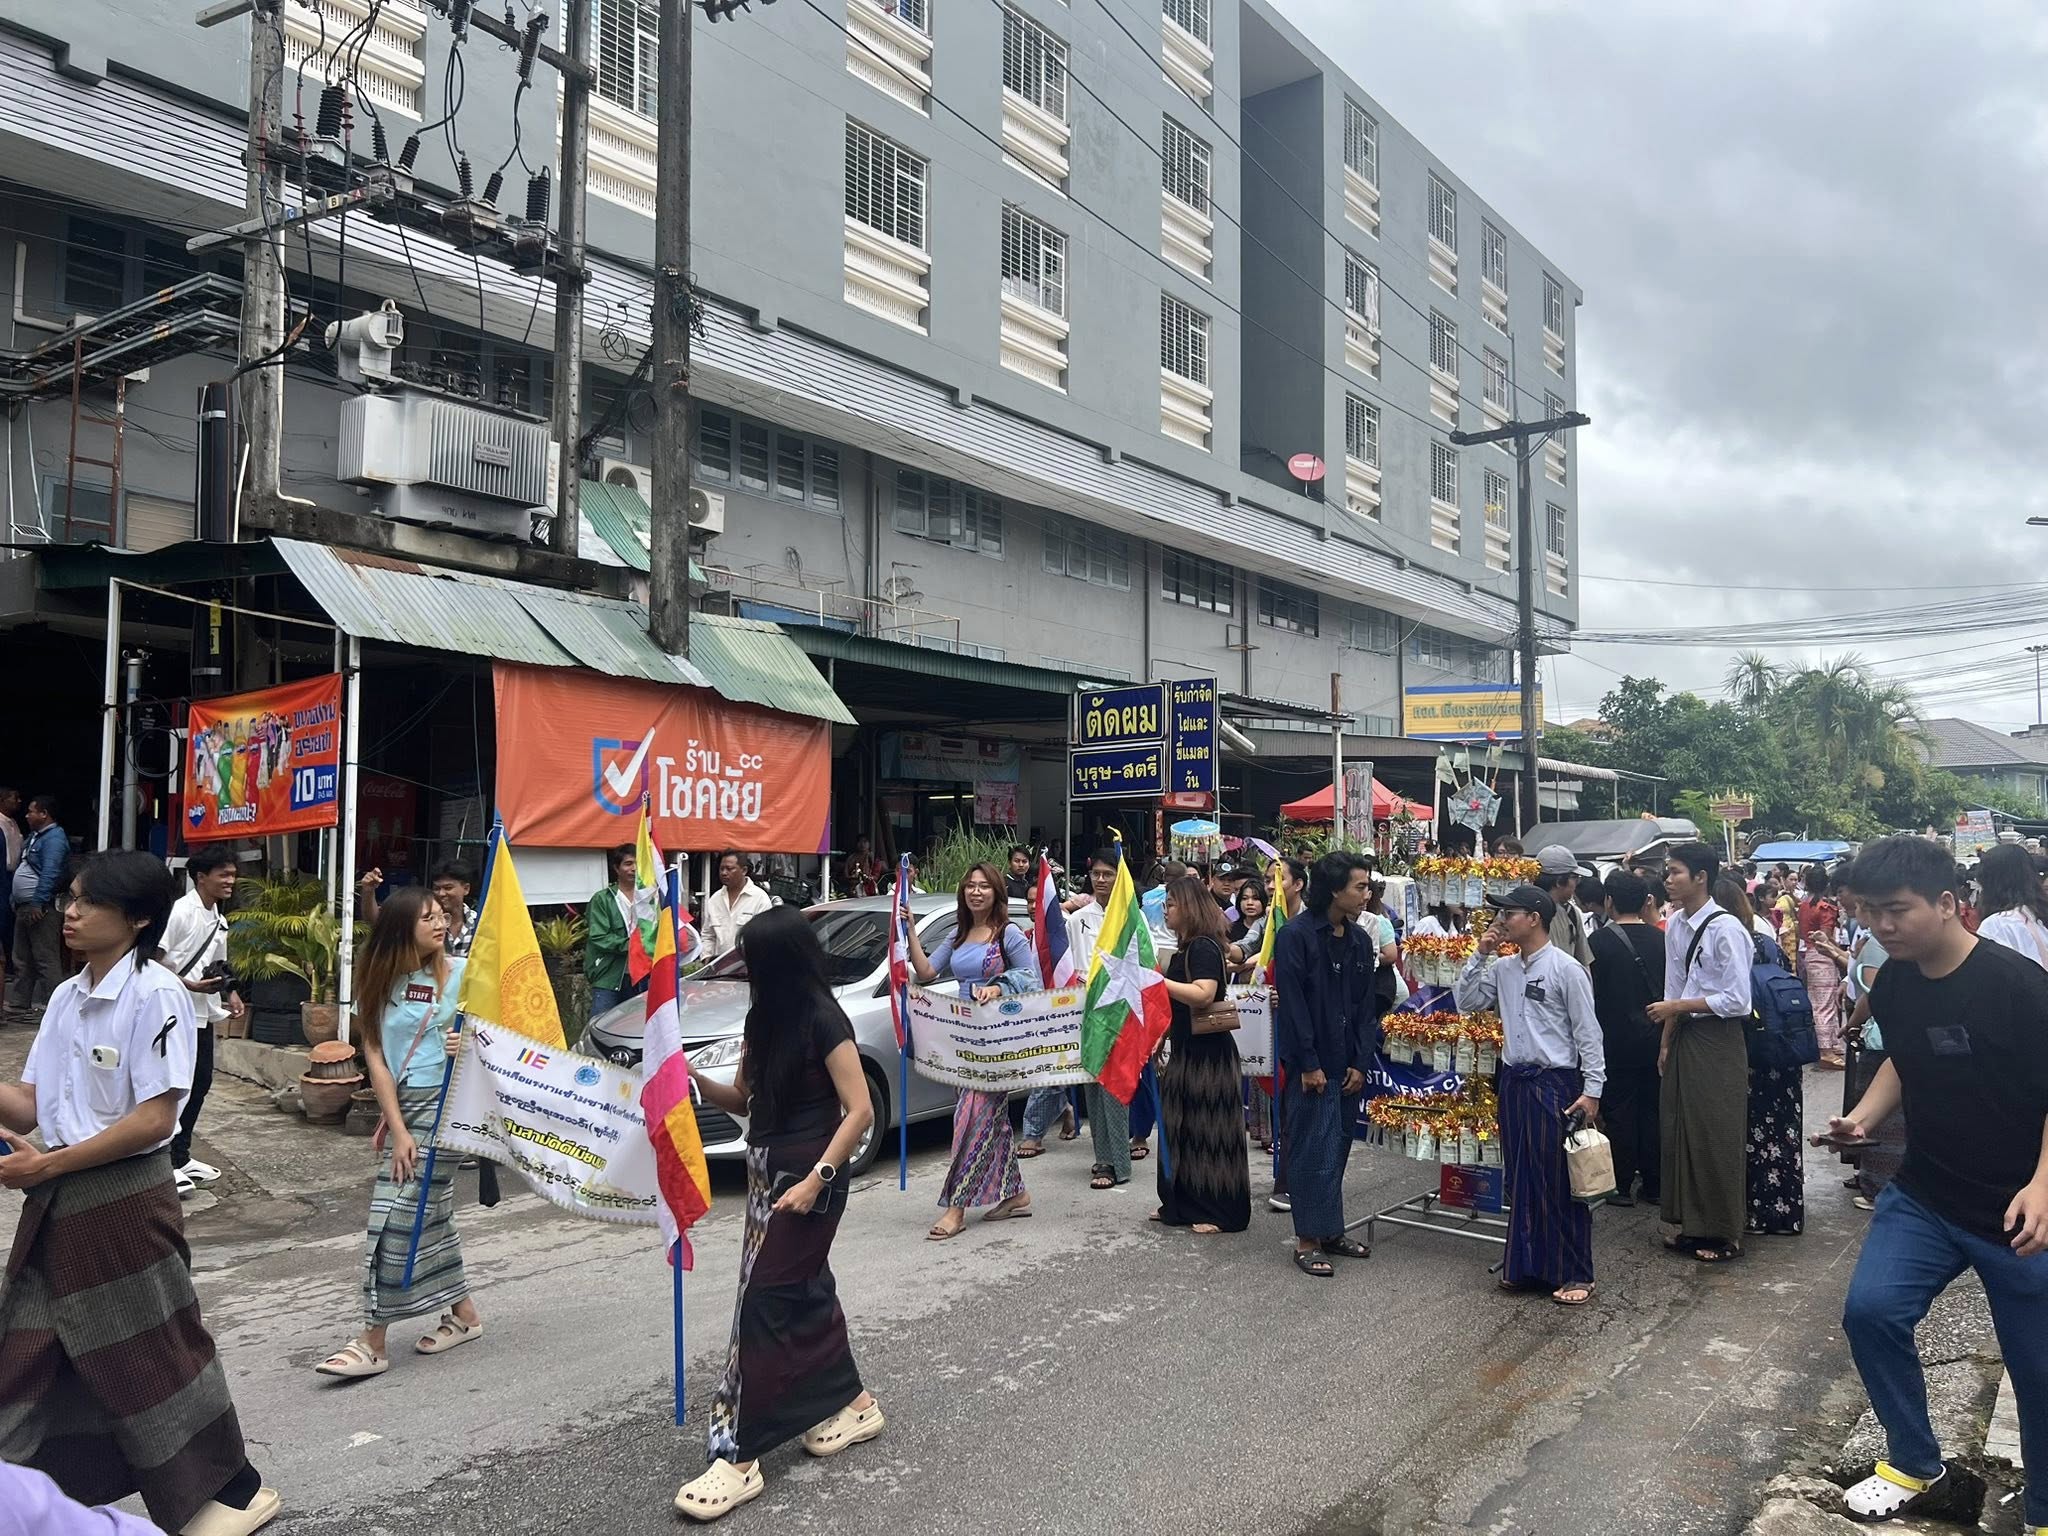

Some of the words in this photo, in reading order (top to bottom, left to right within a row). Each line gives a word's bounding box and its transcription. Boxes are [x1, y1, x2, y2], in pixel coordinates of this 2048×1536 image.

[331, 197, 338, 207] B
[1174, 683, 1213, 704] รับกำจัด
[1085, 696, 1158, 738] ตัดผม
[1177, 713, 1209, 732] ไฝและ
[685, 739, 720, 775] ร้าน
[1176, 735, 1210, 761] ขี้แมลง
[1075, 754, 1158, 790] บุรุษ-สตรี
[1184, 770, 1201, 789] วัน
[295, 768, 316, 803] 10
[656, 755, 763, 823] โชคชัย
[409, 991, 430, 1000] STAFF
